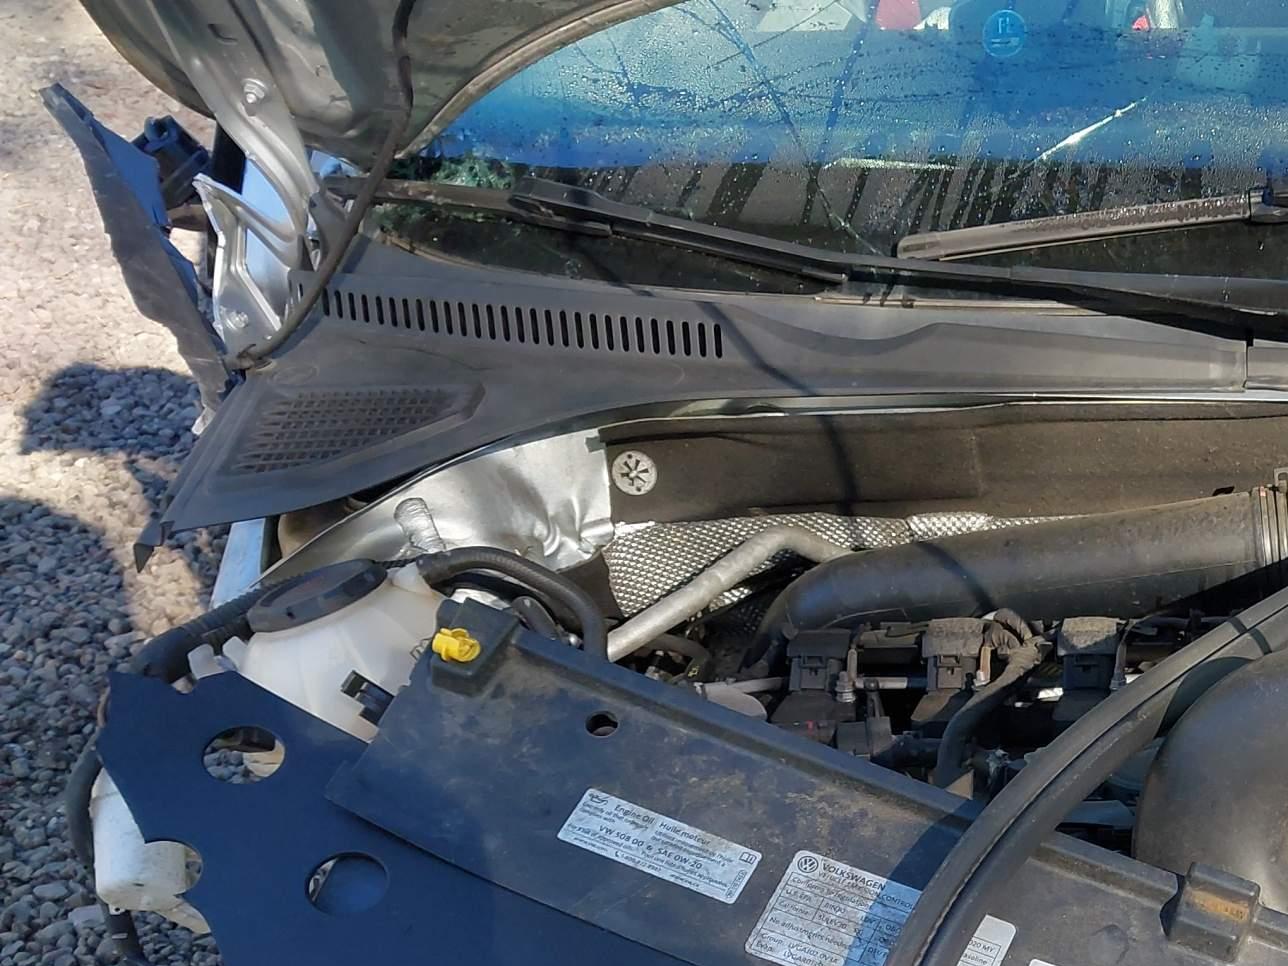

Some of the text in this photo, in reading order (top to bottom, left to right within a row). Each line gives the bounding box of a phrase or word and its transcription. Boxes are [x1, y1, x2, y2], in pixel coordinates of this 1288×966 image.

[613, 803, 643, 819] Engine
[640, 814, 655, 824] Oil
[658, 821, 682, 835] Huile
[679, 829, 711, 845] moteur
[597, 824, 615, 836] VW
[613, 831, 631, 842] 508
[630, 837, 644, 847] 00
[655, 847, 673, 858] SAE
[672, 853, 703, 869] 0W-20
[791, 876, 825, 892] Conforms
[820, 862, 886, 891] VOLKSWAGEN
[968, 939, 982, 948] 020
[962, 952, 988, 965] asoline
